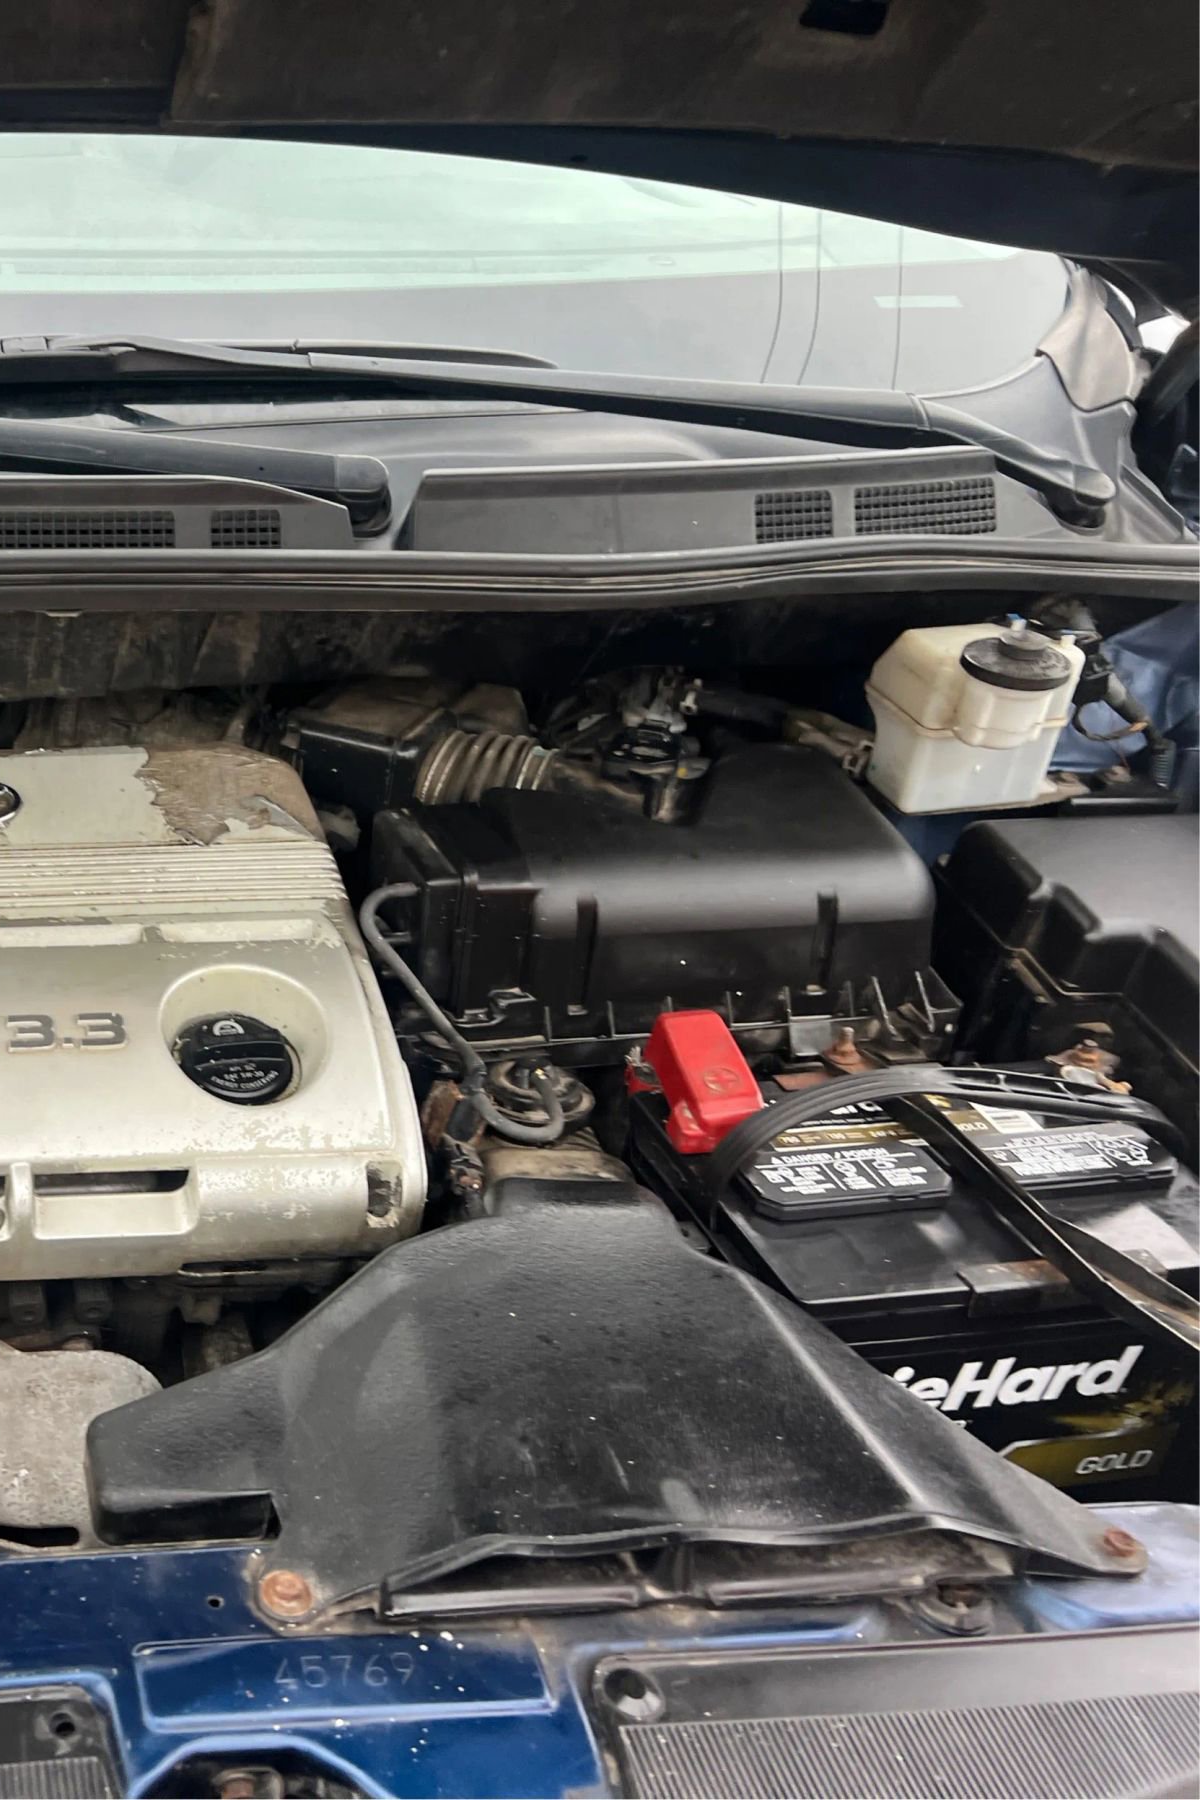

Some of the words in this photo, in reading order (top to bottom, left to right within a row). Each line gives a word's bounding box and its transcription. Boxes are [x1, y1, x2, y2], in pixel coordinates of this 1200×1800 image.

[6, 1013, 128, 1053] 3.3
[954, 1121, 989, 1131] OLD
[782, 1152, 834, 1164] DANGER
[891, 1345, 1144, 1411] ieHard
[1075, 1450, 1153, 1475] GOLD
[273, 1652, 416, 1689] 45769
